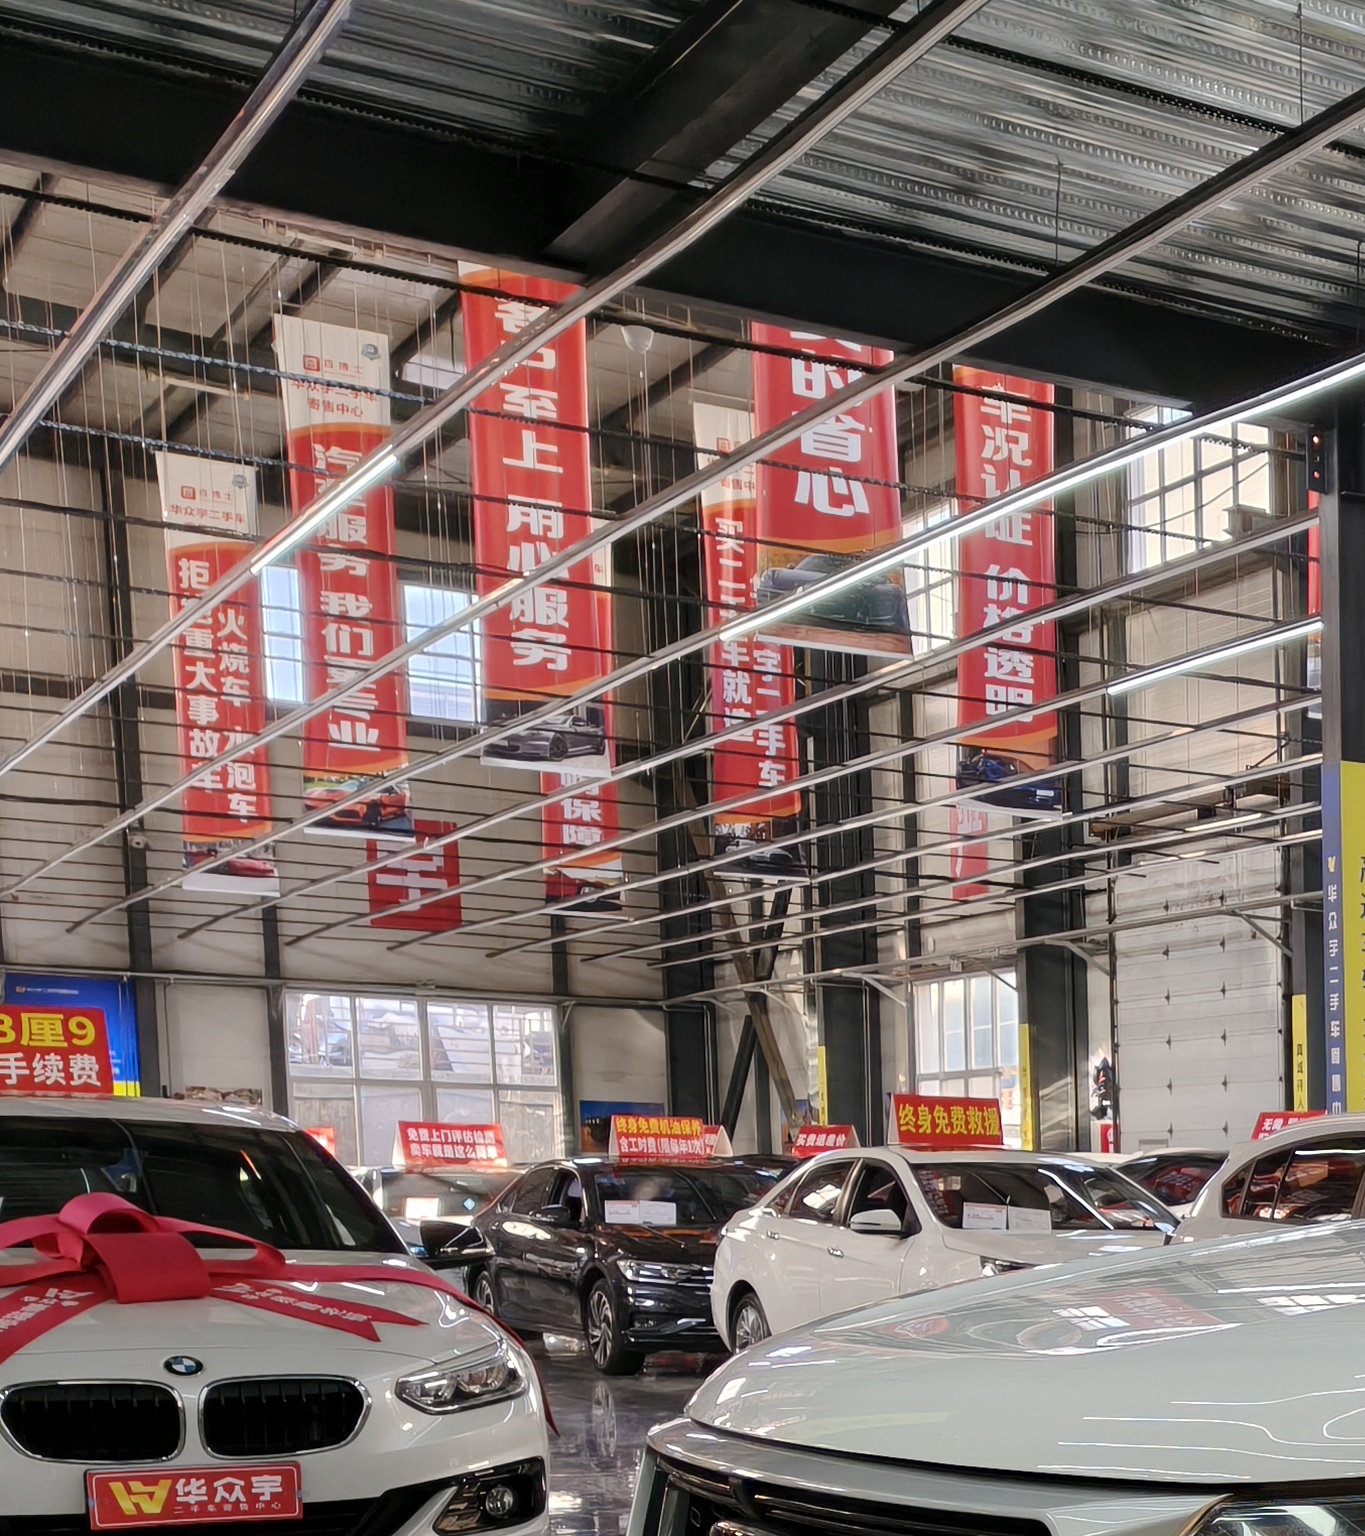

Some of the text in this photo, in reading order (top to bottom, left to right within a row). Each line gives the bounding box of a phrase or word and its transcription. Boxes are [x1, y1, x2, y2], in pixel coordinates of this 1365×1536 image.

[790, 331, 870, 517] 的省心
[980, 383, 1035, 722] 车况认证 价格透明
[217, 608, 259, 824] 火烧车 水泡车
[0, 1052, 101, 1087] 手续费
[899, 1103, 1000, 1135] 终身免费救援
[175, 1475, 283, 1504] 华众宇
